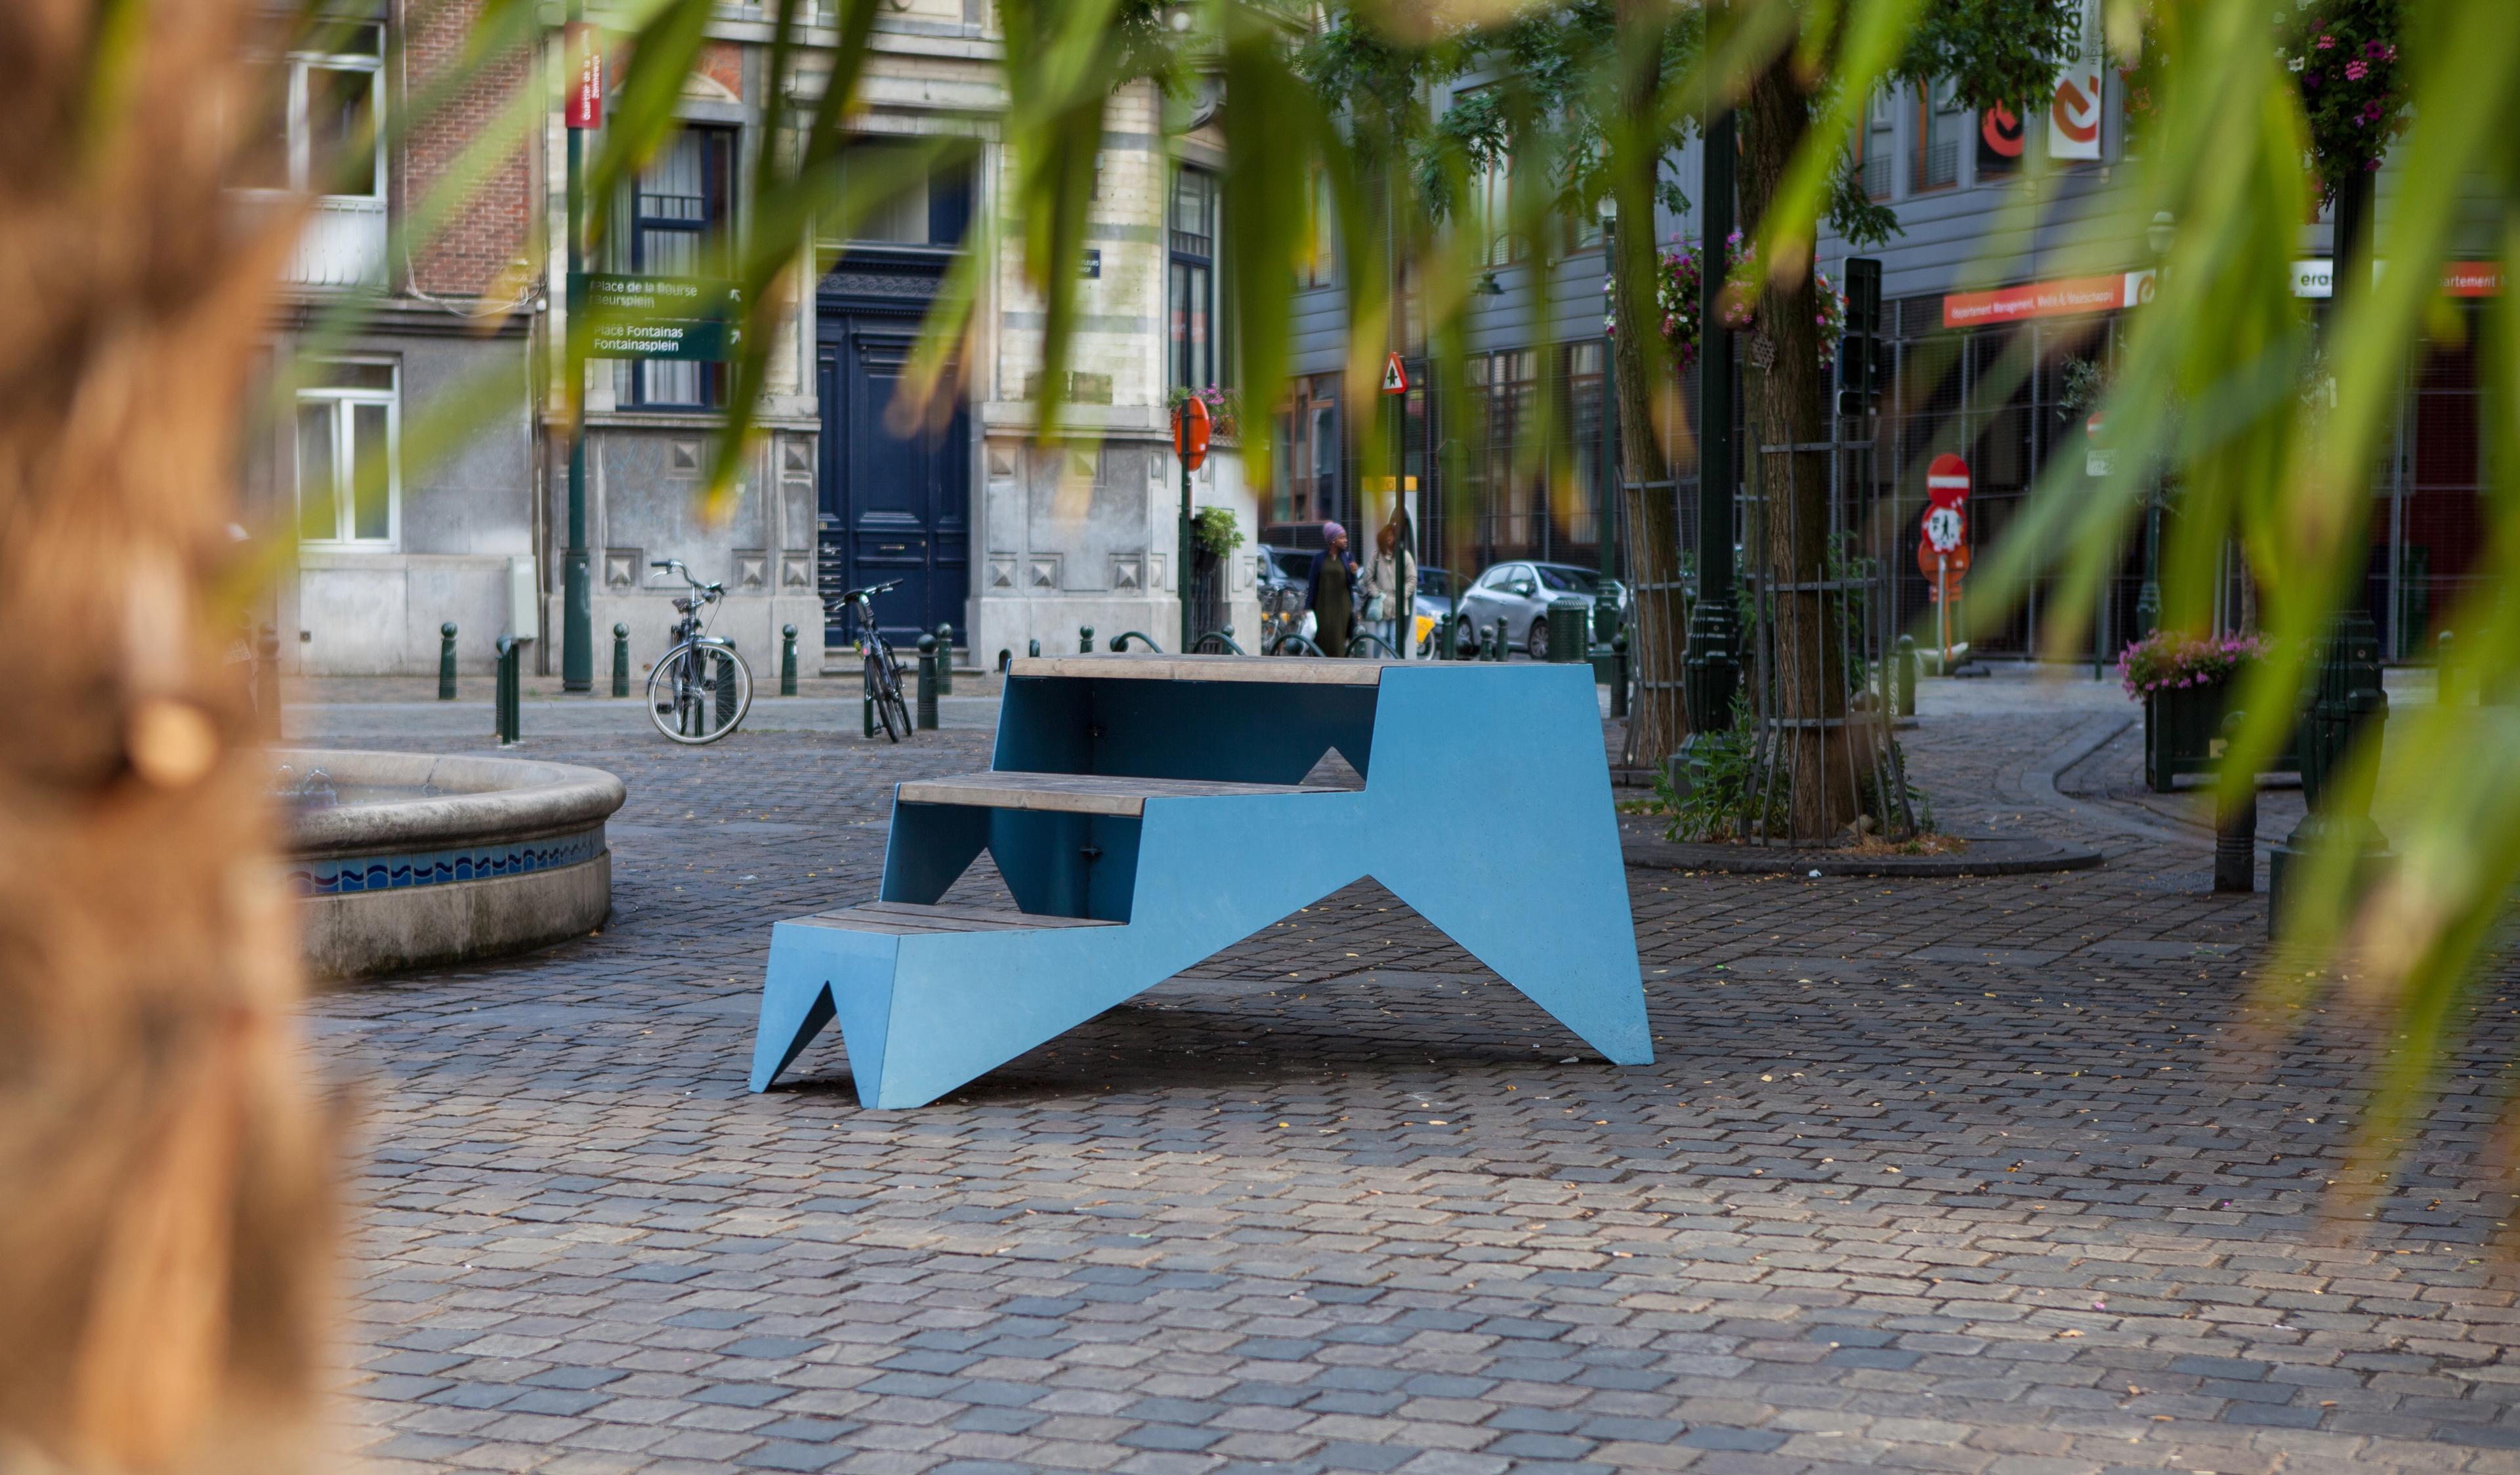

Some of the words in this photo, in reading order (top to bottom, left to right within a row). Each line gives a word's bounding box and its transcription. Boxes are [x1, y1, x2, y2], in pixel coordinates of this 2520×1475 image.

[627, 281, 642, 293] de
[645, 281, 654, 293] la
[658, 282, 698, 297] Bourse
[627, 325, 683, 337] Fontainas
[594, 339, 679, 352] Fontainasplein
